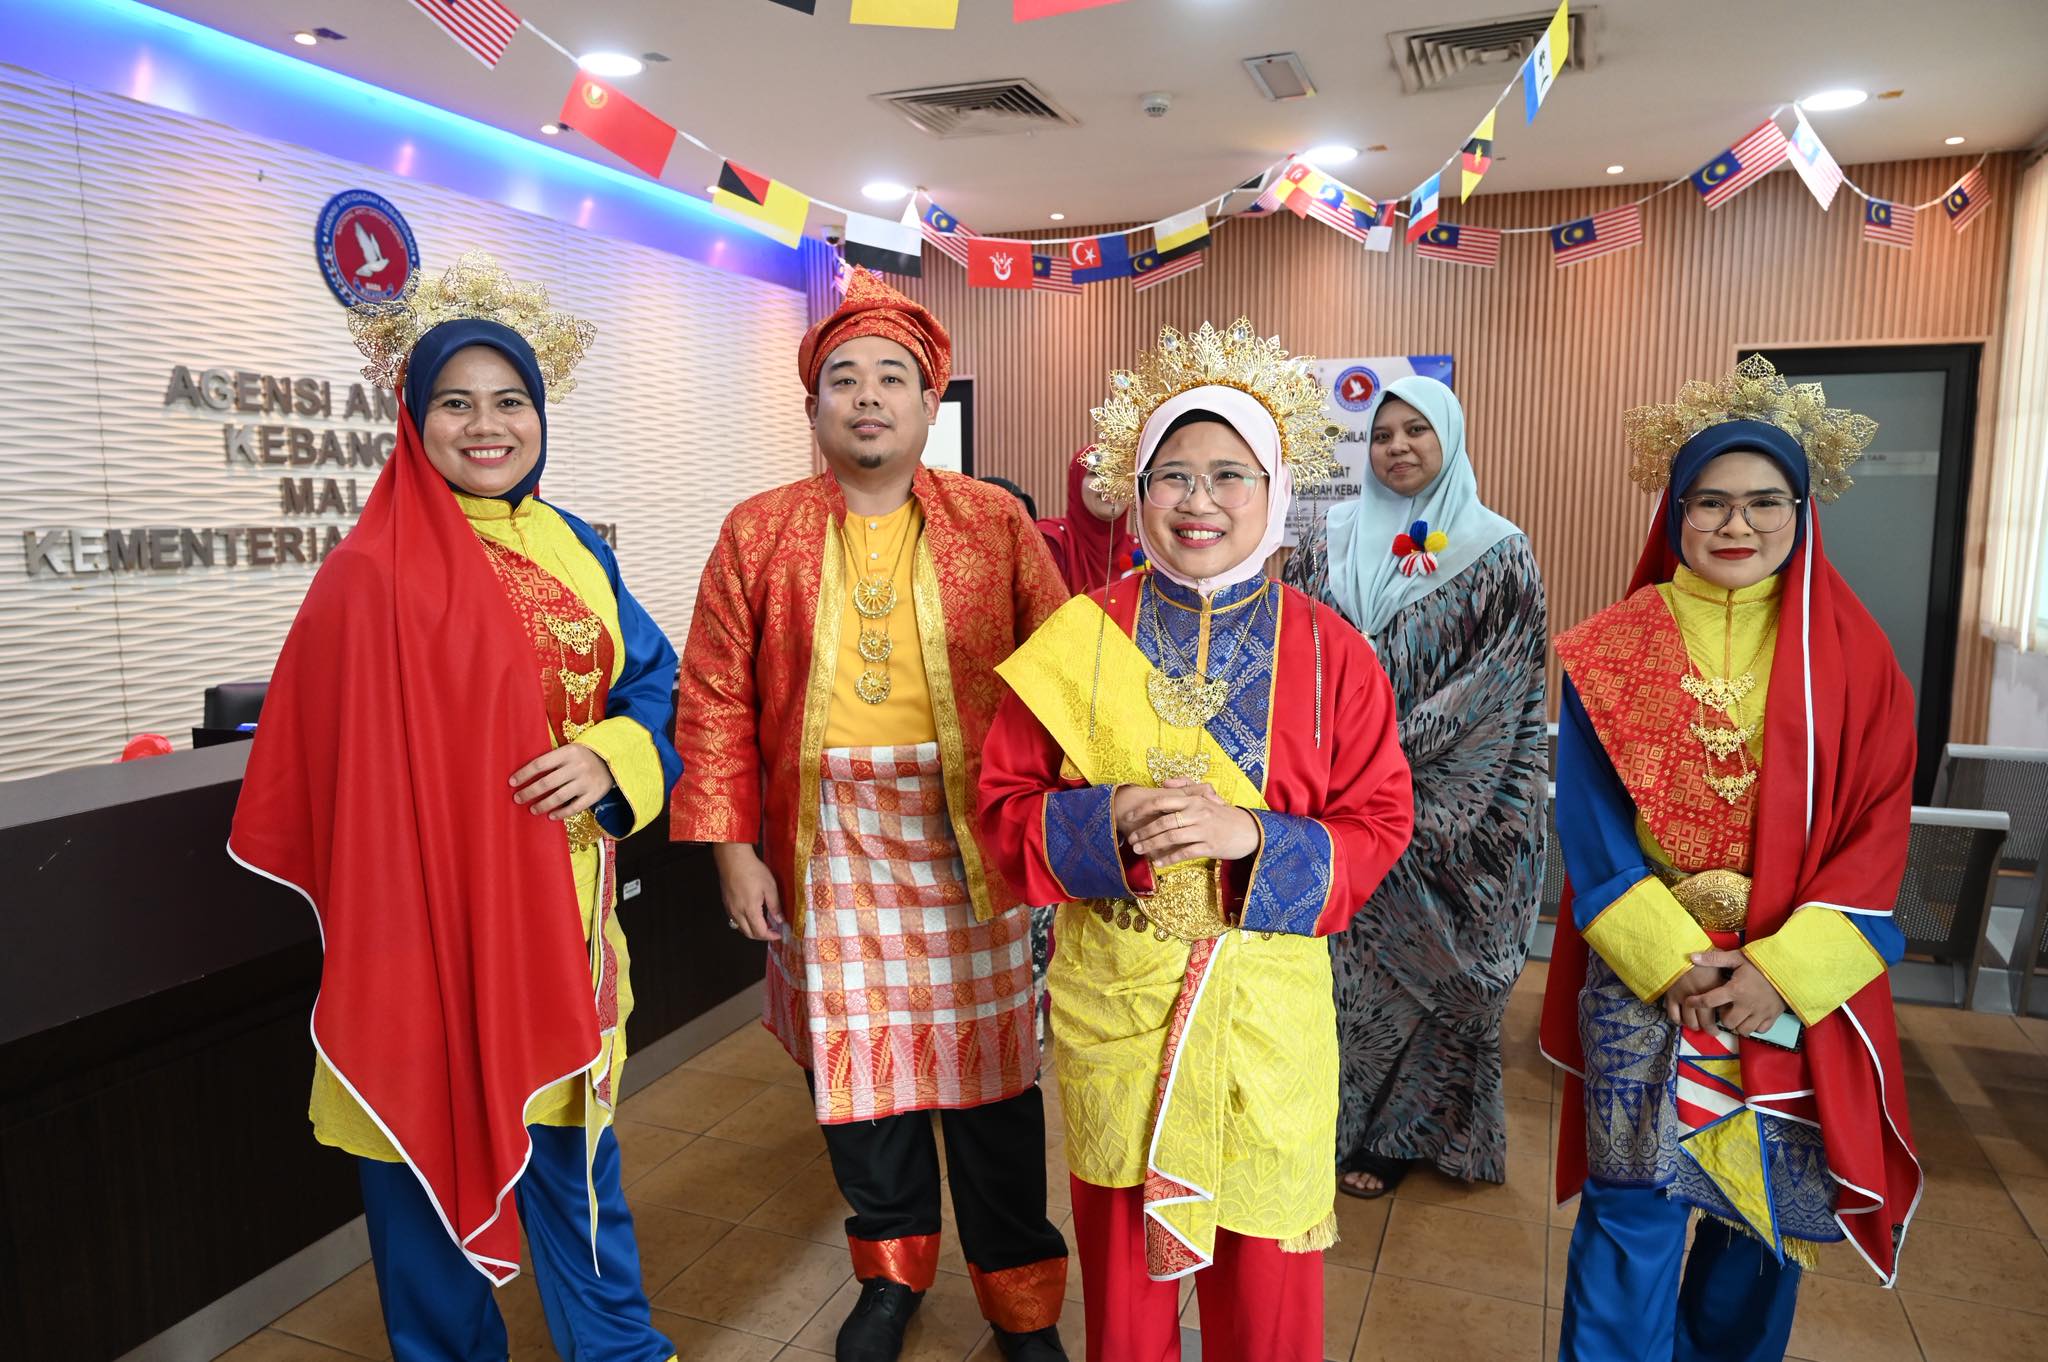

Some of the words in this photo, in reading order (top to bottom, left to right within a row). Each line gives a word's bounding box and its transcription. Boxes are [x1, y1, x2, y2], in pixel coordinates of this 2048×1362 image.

[164, 365, 331, 418] AGENSI
[343, 382, 398, 422] AN
[223, 423, 397, 468] KEBANG
[281, 477, 364, 515] MAL
[23, 525, 345, 576] KEMENTERIA
